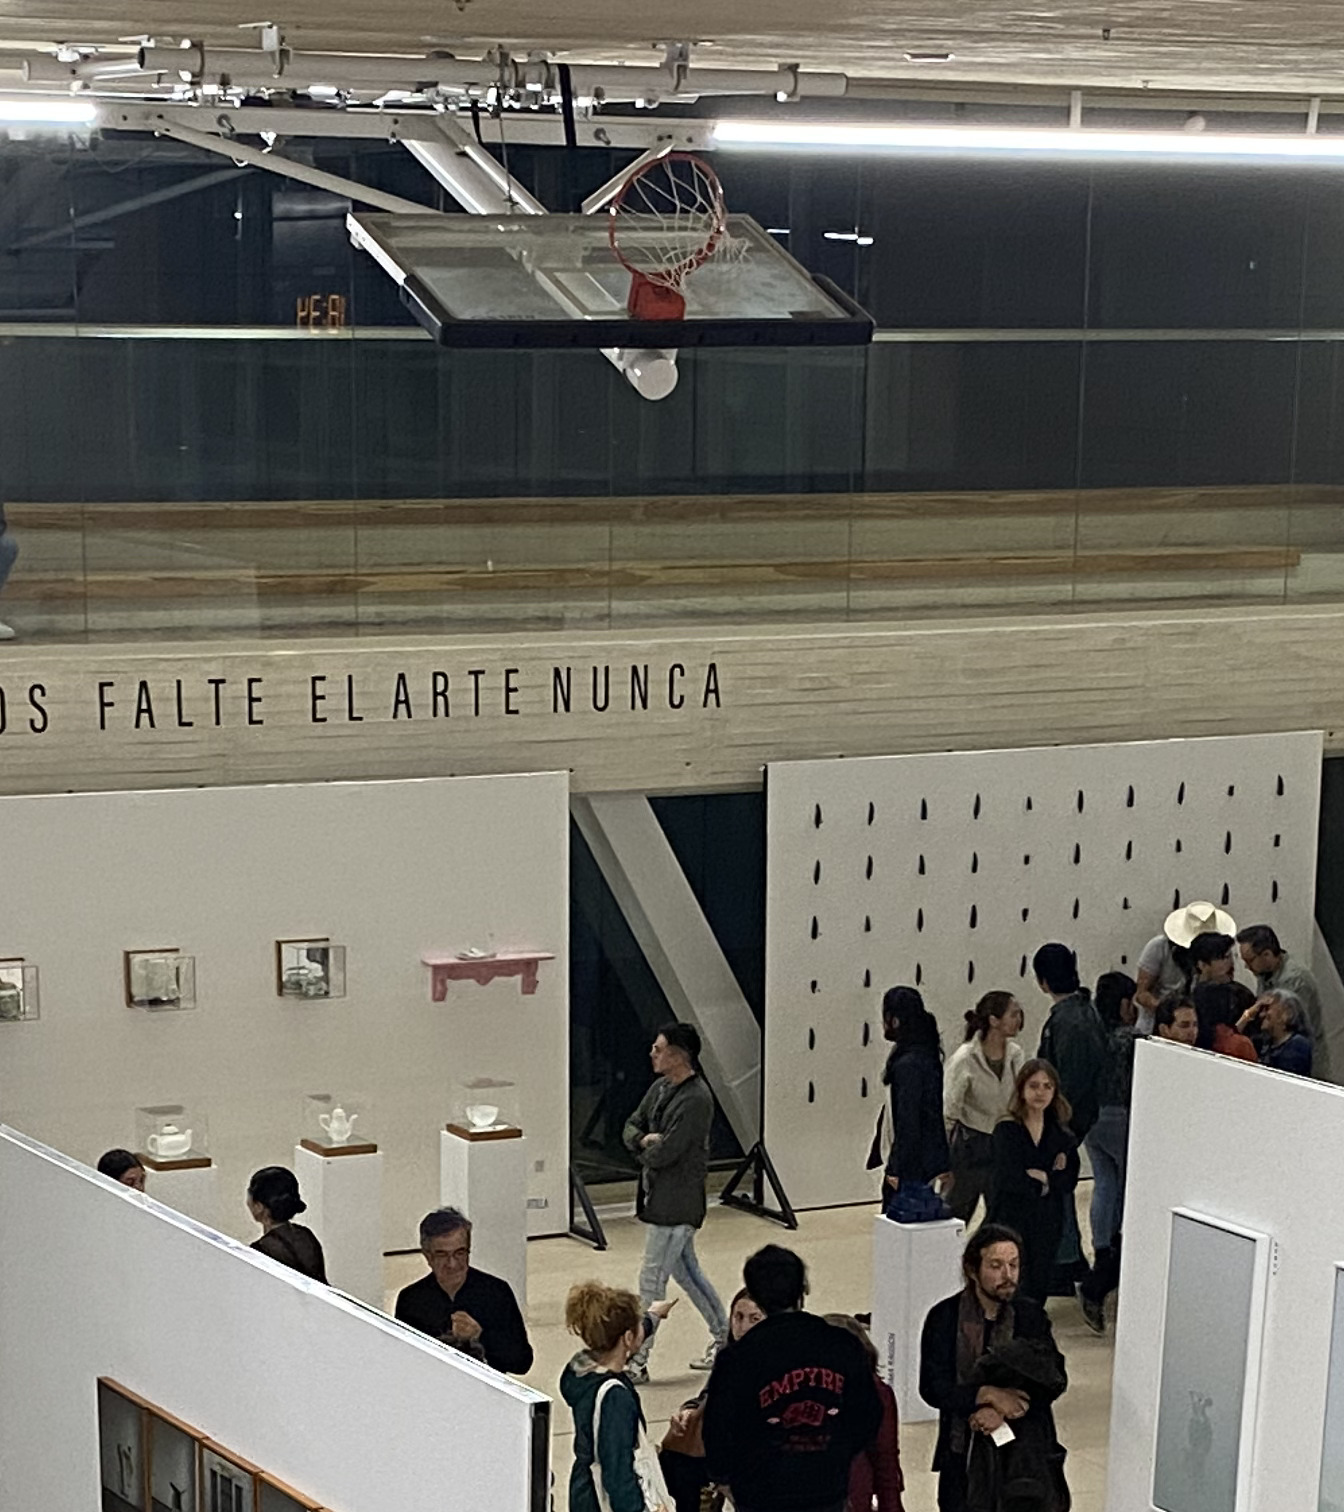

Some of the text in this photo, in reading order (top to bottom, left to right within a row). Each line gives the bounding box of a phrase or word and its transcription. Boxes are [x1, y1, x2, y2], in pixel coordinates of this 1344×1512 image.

[98, 677, 264, 731] FALTE
[311, 674, 364, 723] EL
[392, 668, 520, 720] ARTE
[553, 662, 721, 714] NUNCA
[759, 1367, 845, 1408] EMPYRE
